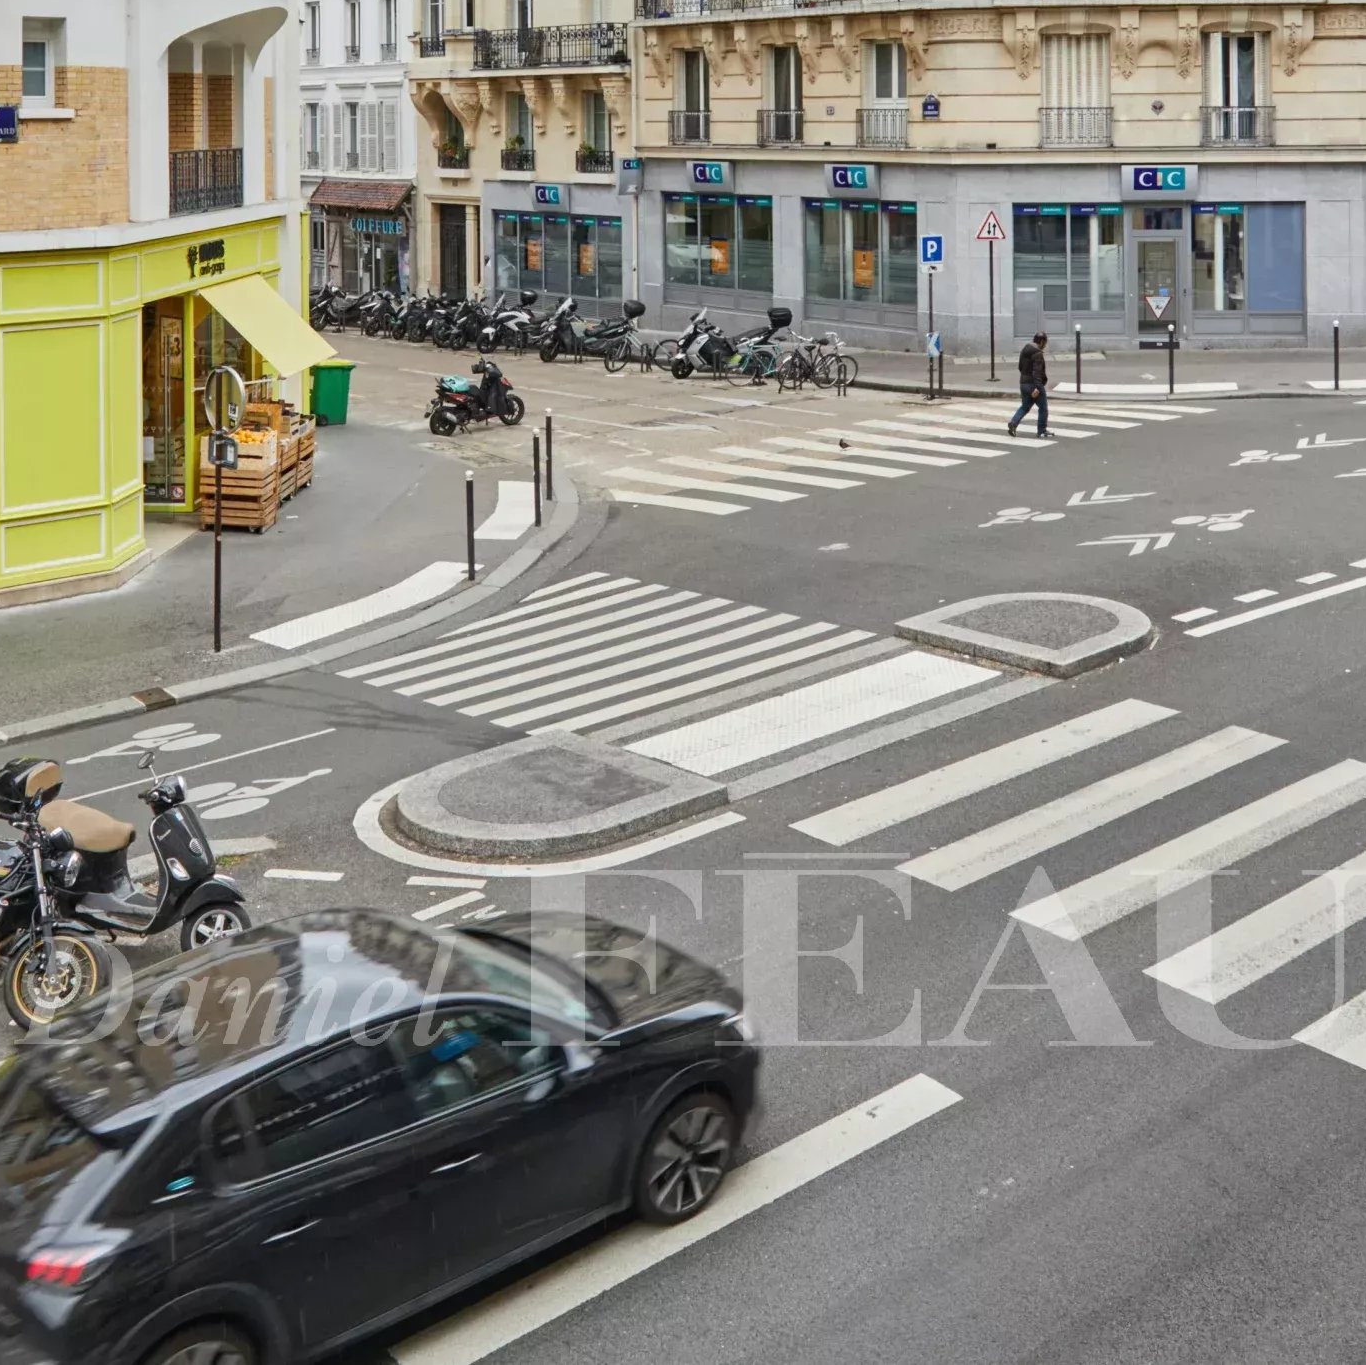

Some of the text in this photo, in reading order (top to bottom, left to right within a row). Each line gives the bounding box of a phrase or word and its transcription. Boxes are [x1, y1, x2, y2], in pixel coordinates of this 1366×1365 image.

[695, 167, 720, 180] CIC
[836, 170, 864, 185] CIC
[1138, 171, 1181, 187] CIC
[537, 188, 559, 202] CIC
[349, 217, 403, 235] COIFFURE
[927, 240, 938, 259] P
